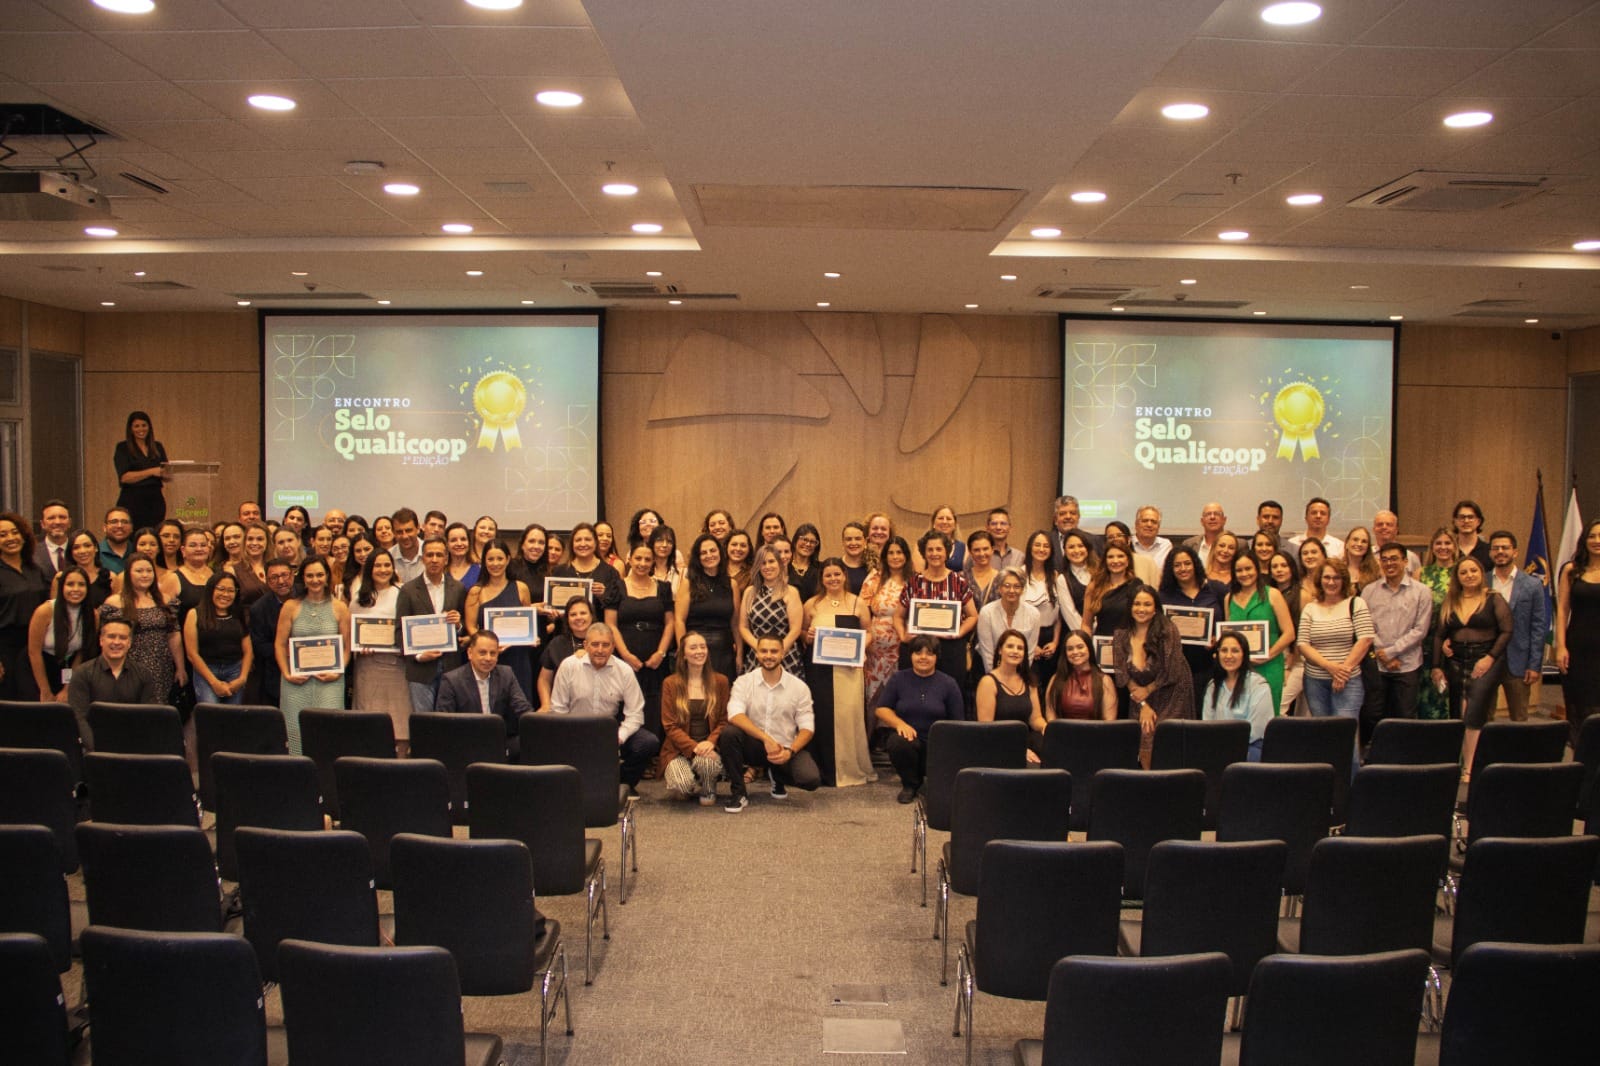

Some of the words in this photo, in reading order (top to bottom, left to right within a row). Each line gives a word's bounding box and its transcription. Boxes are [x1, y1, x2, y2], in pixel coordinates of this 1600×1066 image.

[334, 398, 411, 407] ENCONTRO
[334, 407, 391, 431] Selo
[1135, 406, 1212, 417] ENCONTRO
[1135, 417, 1192, 440] Selo
[334, 431, 467, 461] Qualicoop
[412, 455, 449, 466] EDIÇÃO
[1134, 440, 1267, 471] Qualicoop
[1212, 465, 1249, 476] EDIÇÃO
